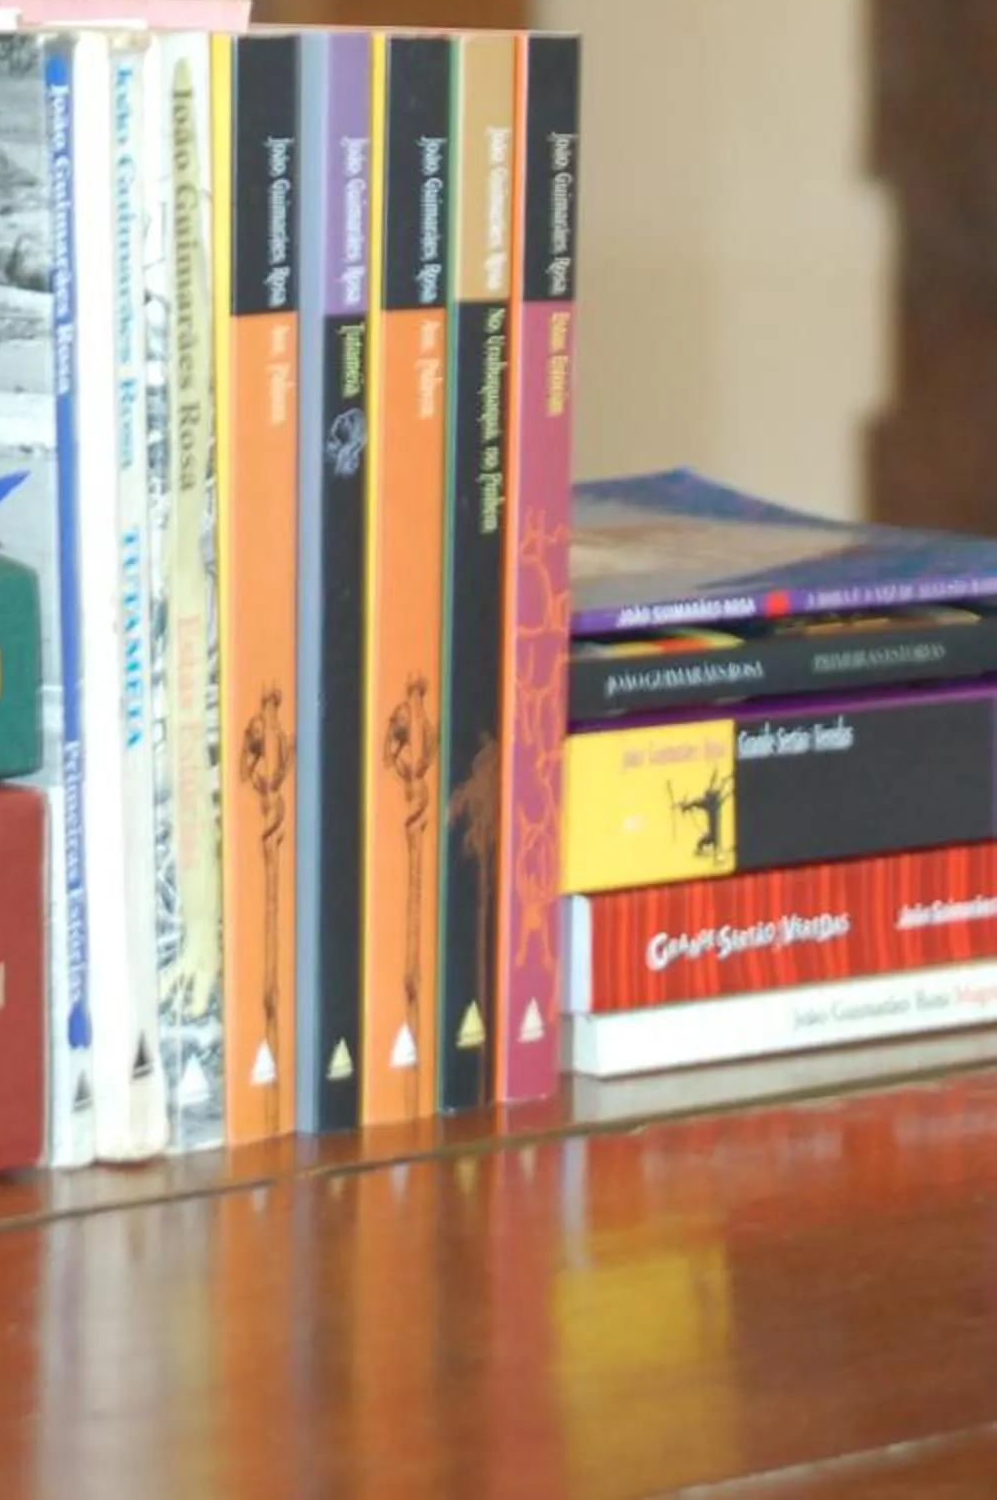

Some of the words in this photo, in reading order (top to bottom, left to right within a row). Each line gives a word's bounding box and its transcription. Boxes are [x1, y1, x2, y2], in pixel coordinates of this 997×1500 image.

[264, 135, 294, 177] João
[415, 135, 447, 176] João
[547, 131, 578, 170] João
[268, 178, 291, 265] Guimarães
[420, 177, 443, 262] Guimarães
[551, 172, 573, 254] Guimarães
[263, 266, 291, 307] Rosa
[415, 263, 442, 304] Rosa
[545, 256, 571, 297] Rosa
[177, 401, 201, 492] Rosa
